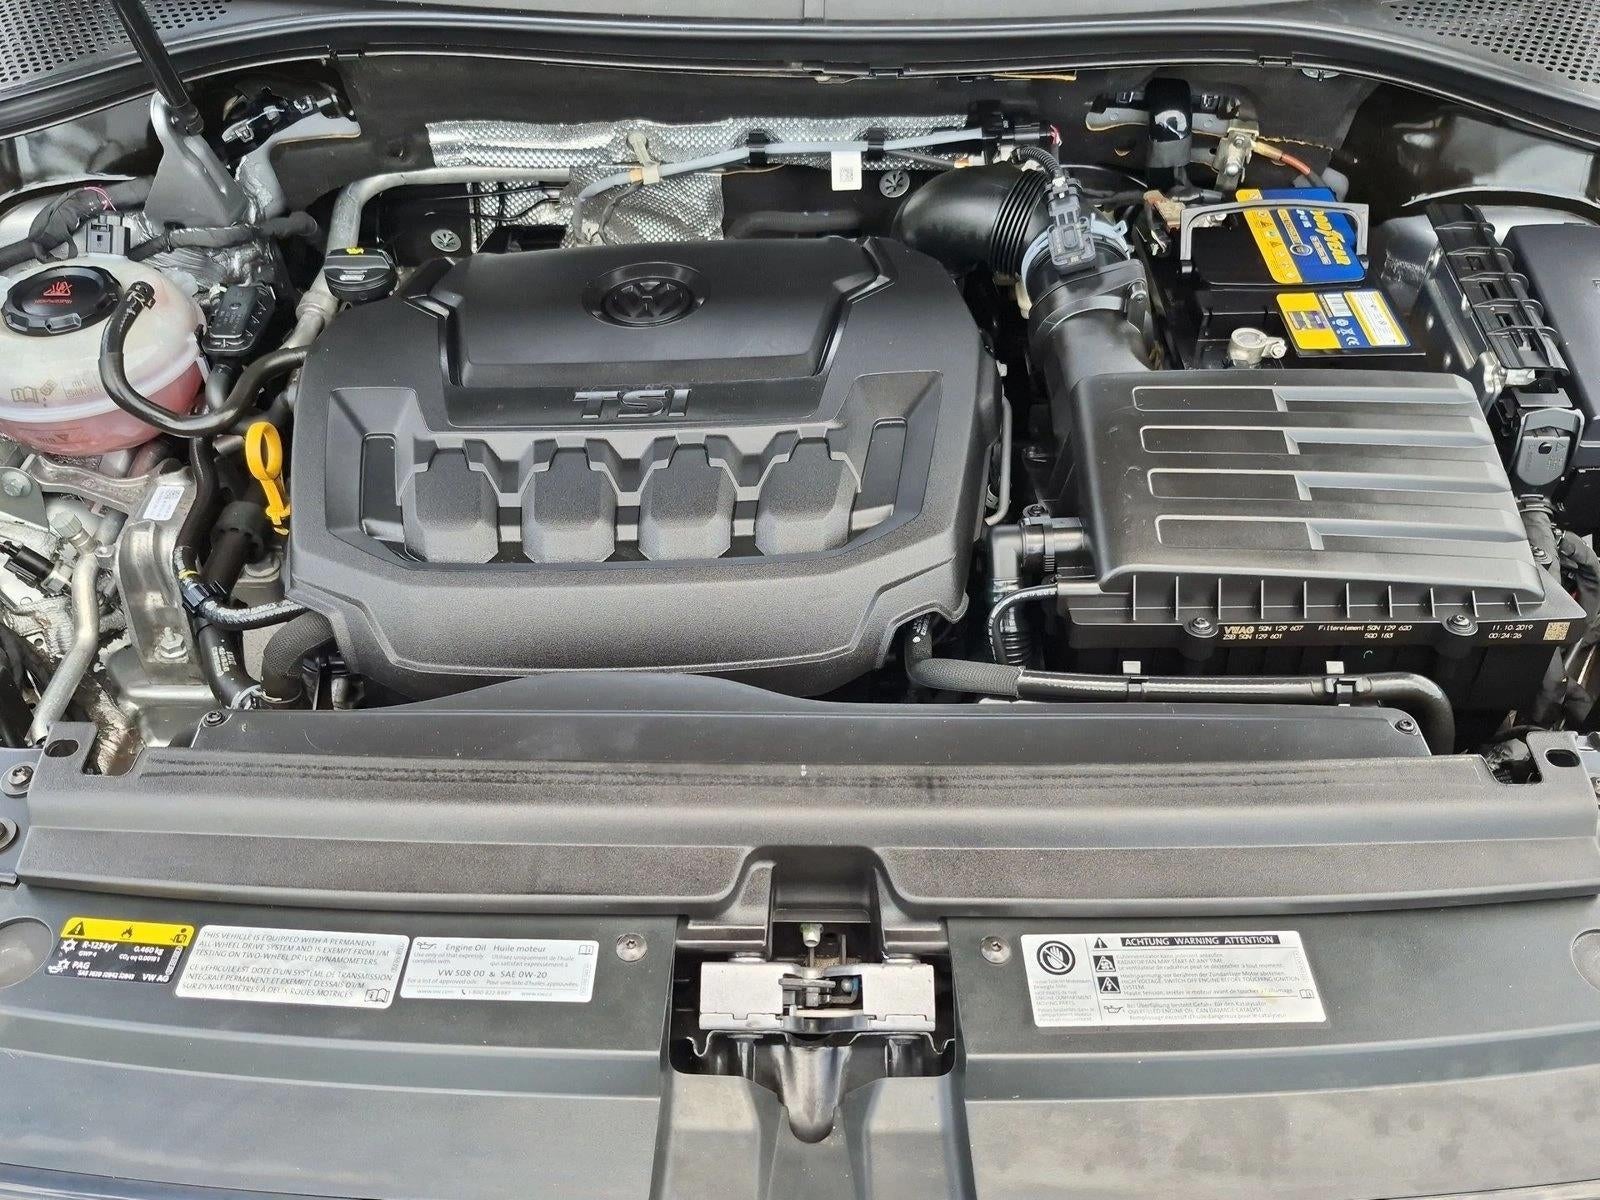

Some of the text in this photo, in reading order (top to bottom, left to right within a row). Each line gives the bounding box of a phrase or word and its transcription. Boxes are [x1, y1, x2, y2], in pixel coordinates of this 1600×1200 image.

[573, 389, 692, 419] TSI
[1125, 938, 1170, 946] ACHTUNG
[1224, 936, 1274, 944] ATTENTION
[445, 944, 473, 952] Engine
